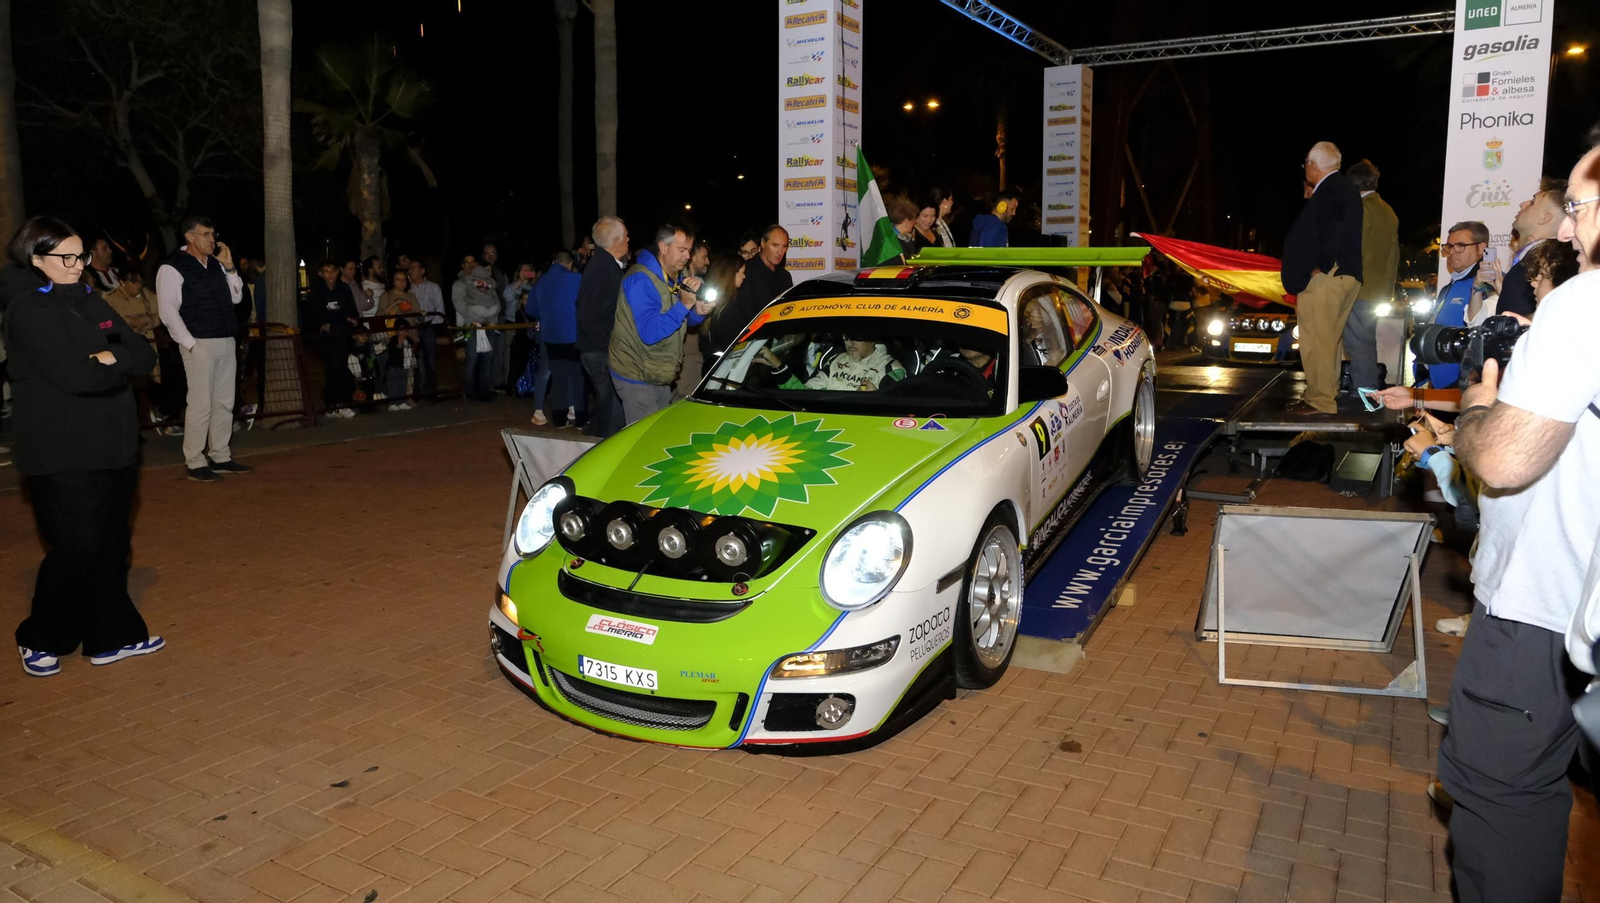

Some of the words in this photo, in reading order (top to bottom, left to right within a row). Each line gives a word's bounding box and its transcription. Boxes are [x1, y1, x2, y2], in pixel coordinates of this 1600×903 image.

[1469, 7, 1497, 18] UNED
[1510, 3, 1536, 11] ALMERÍA
[792, 14, 818, 25] Recalvi
[1463, 35, 1540, 61] gasolia
[787, 75, 825, 86] Rallycar
[1492, 76, 1535, 86] Fornieles
[1491, 87, 1499, 96] &
[1502, 86, 1534, 95] albesa
[792, 98, 818, 108] Recalvi
[1460, 111, 1534, 130] Phonika
[787, 157, 824, 167] Rallycar
[792, 179, 818, 188] Recalvi
[1465, 184, 1514, 208] Enix
[789, 238, 823, 248] Rallycar
[792, 260, 817, 268] Recalvi
[799, 303, 852, 312] AUTOMÓVIL
[901, 304, 944, 314] ALMERÍA
[1034, 422, 1046, 454] 9
[909, 606, 950, 644] zapata
[911, 627, 950, 662] PELUQUEROS
[587, 660, 618, 680] 7315
[626, 669, 655, 688] KXS
[680, 670, 716, 679] PLEMAR
